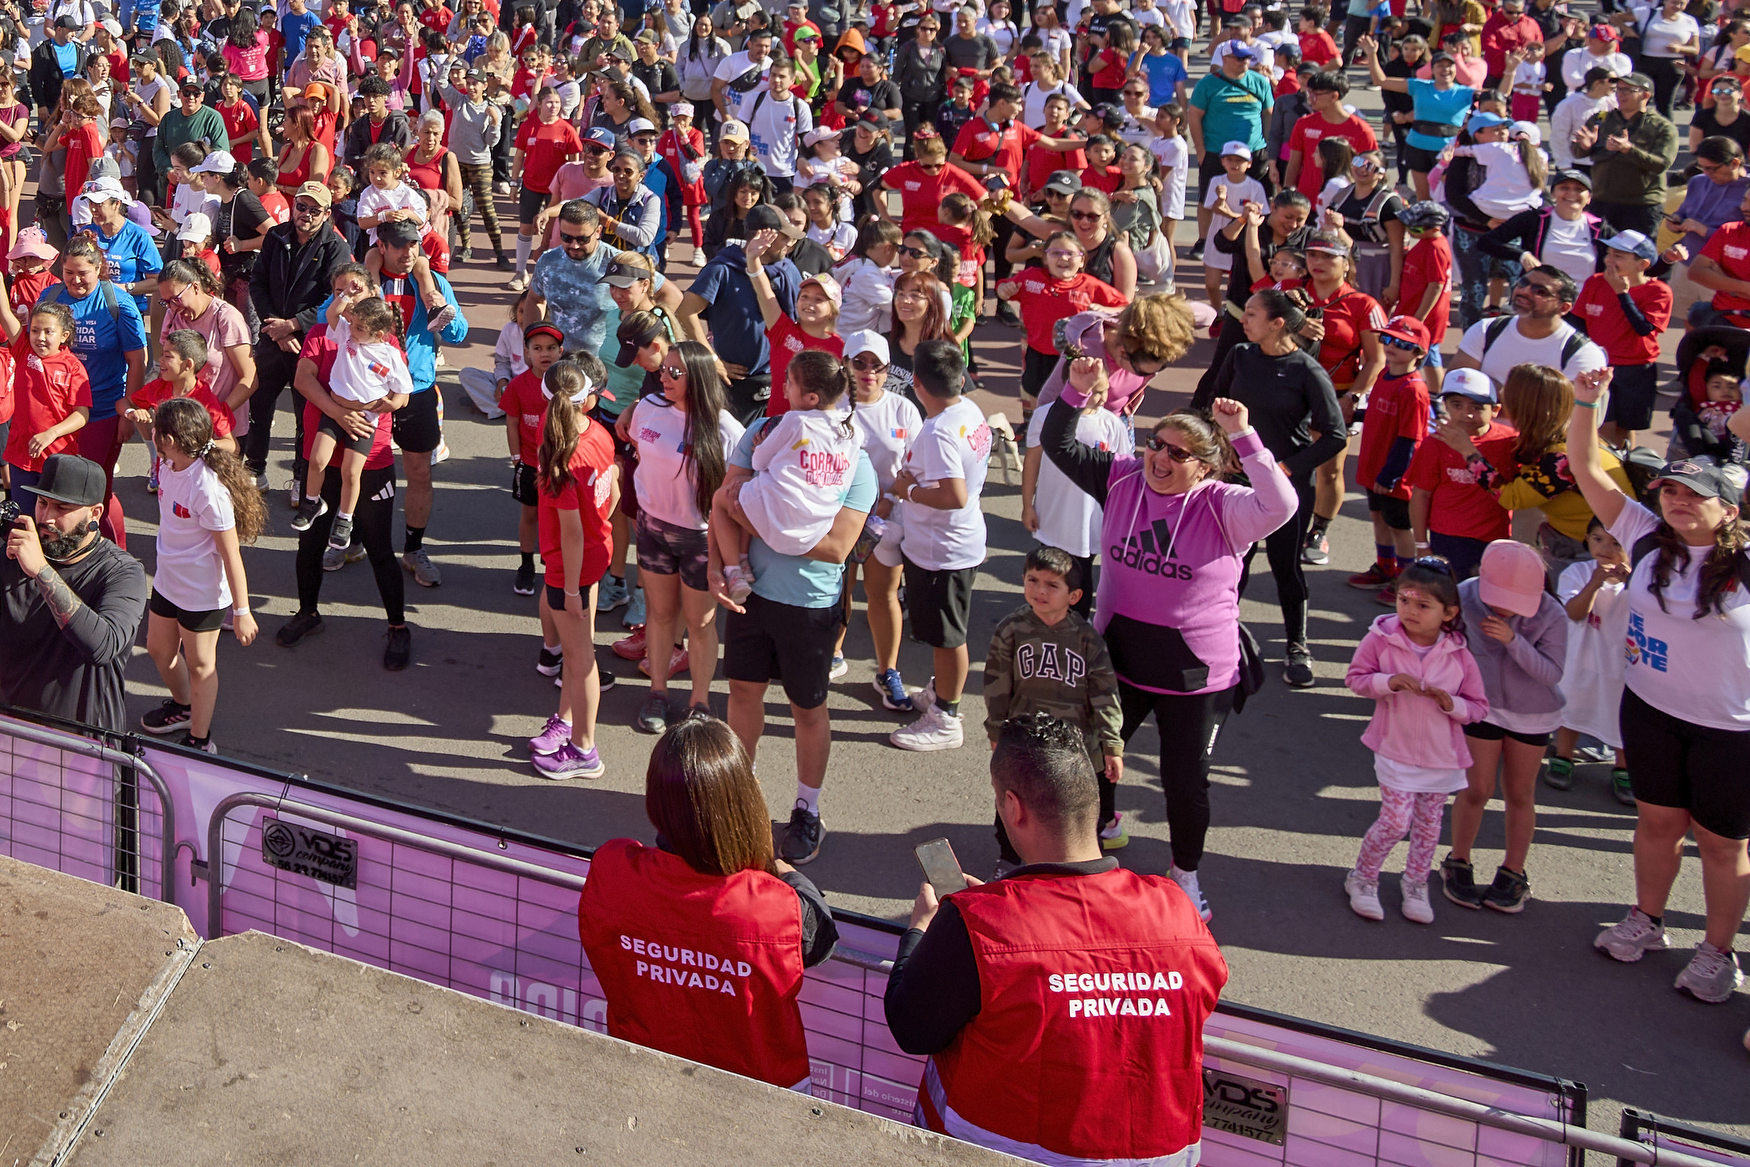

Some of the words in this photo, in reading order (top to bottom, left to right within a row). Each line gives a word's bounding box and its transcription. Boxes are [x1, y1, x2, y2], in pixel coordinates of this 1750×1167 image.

[800, 449, 850, 473] CORRIDA
[1110, 545, 1193, 581] adidas
[1017, 642, 1085, 687] GAP
[1640, 646, 1668, 673] TE
[299, 832, 353, 862] VDS
[296, 851, 353, 877] company
[620, 934, 752, 977] SEGURIDAD
[636, 960, 736, 997] PRIVADA
[1048, 971, 1183, 993] SEGURIDAD
[1069, 998, 1171, 1018] PRIVADA
[1203, 1099, 1279, 1130] mpany
